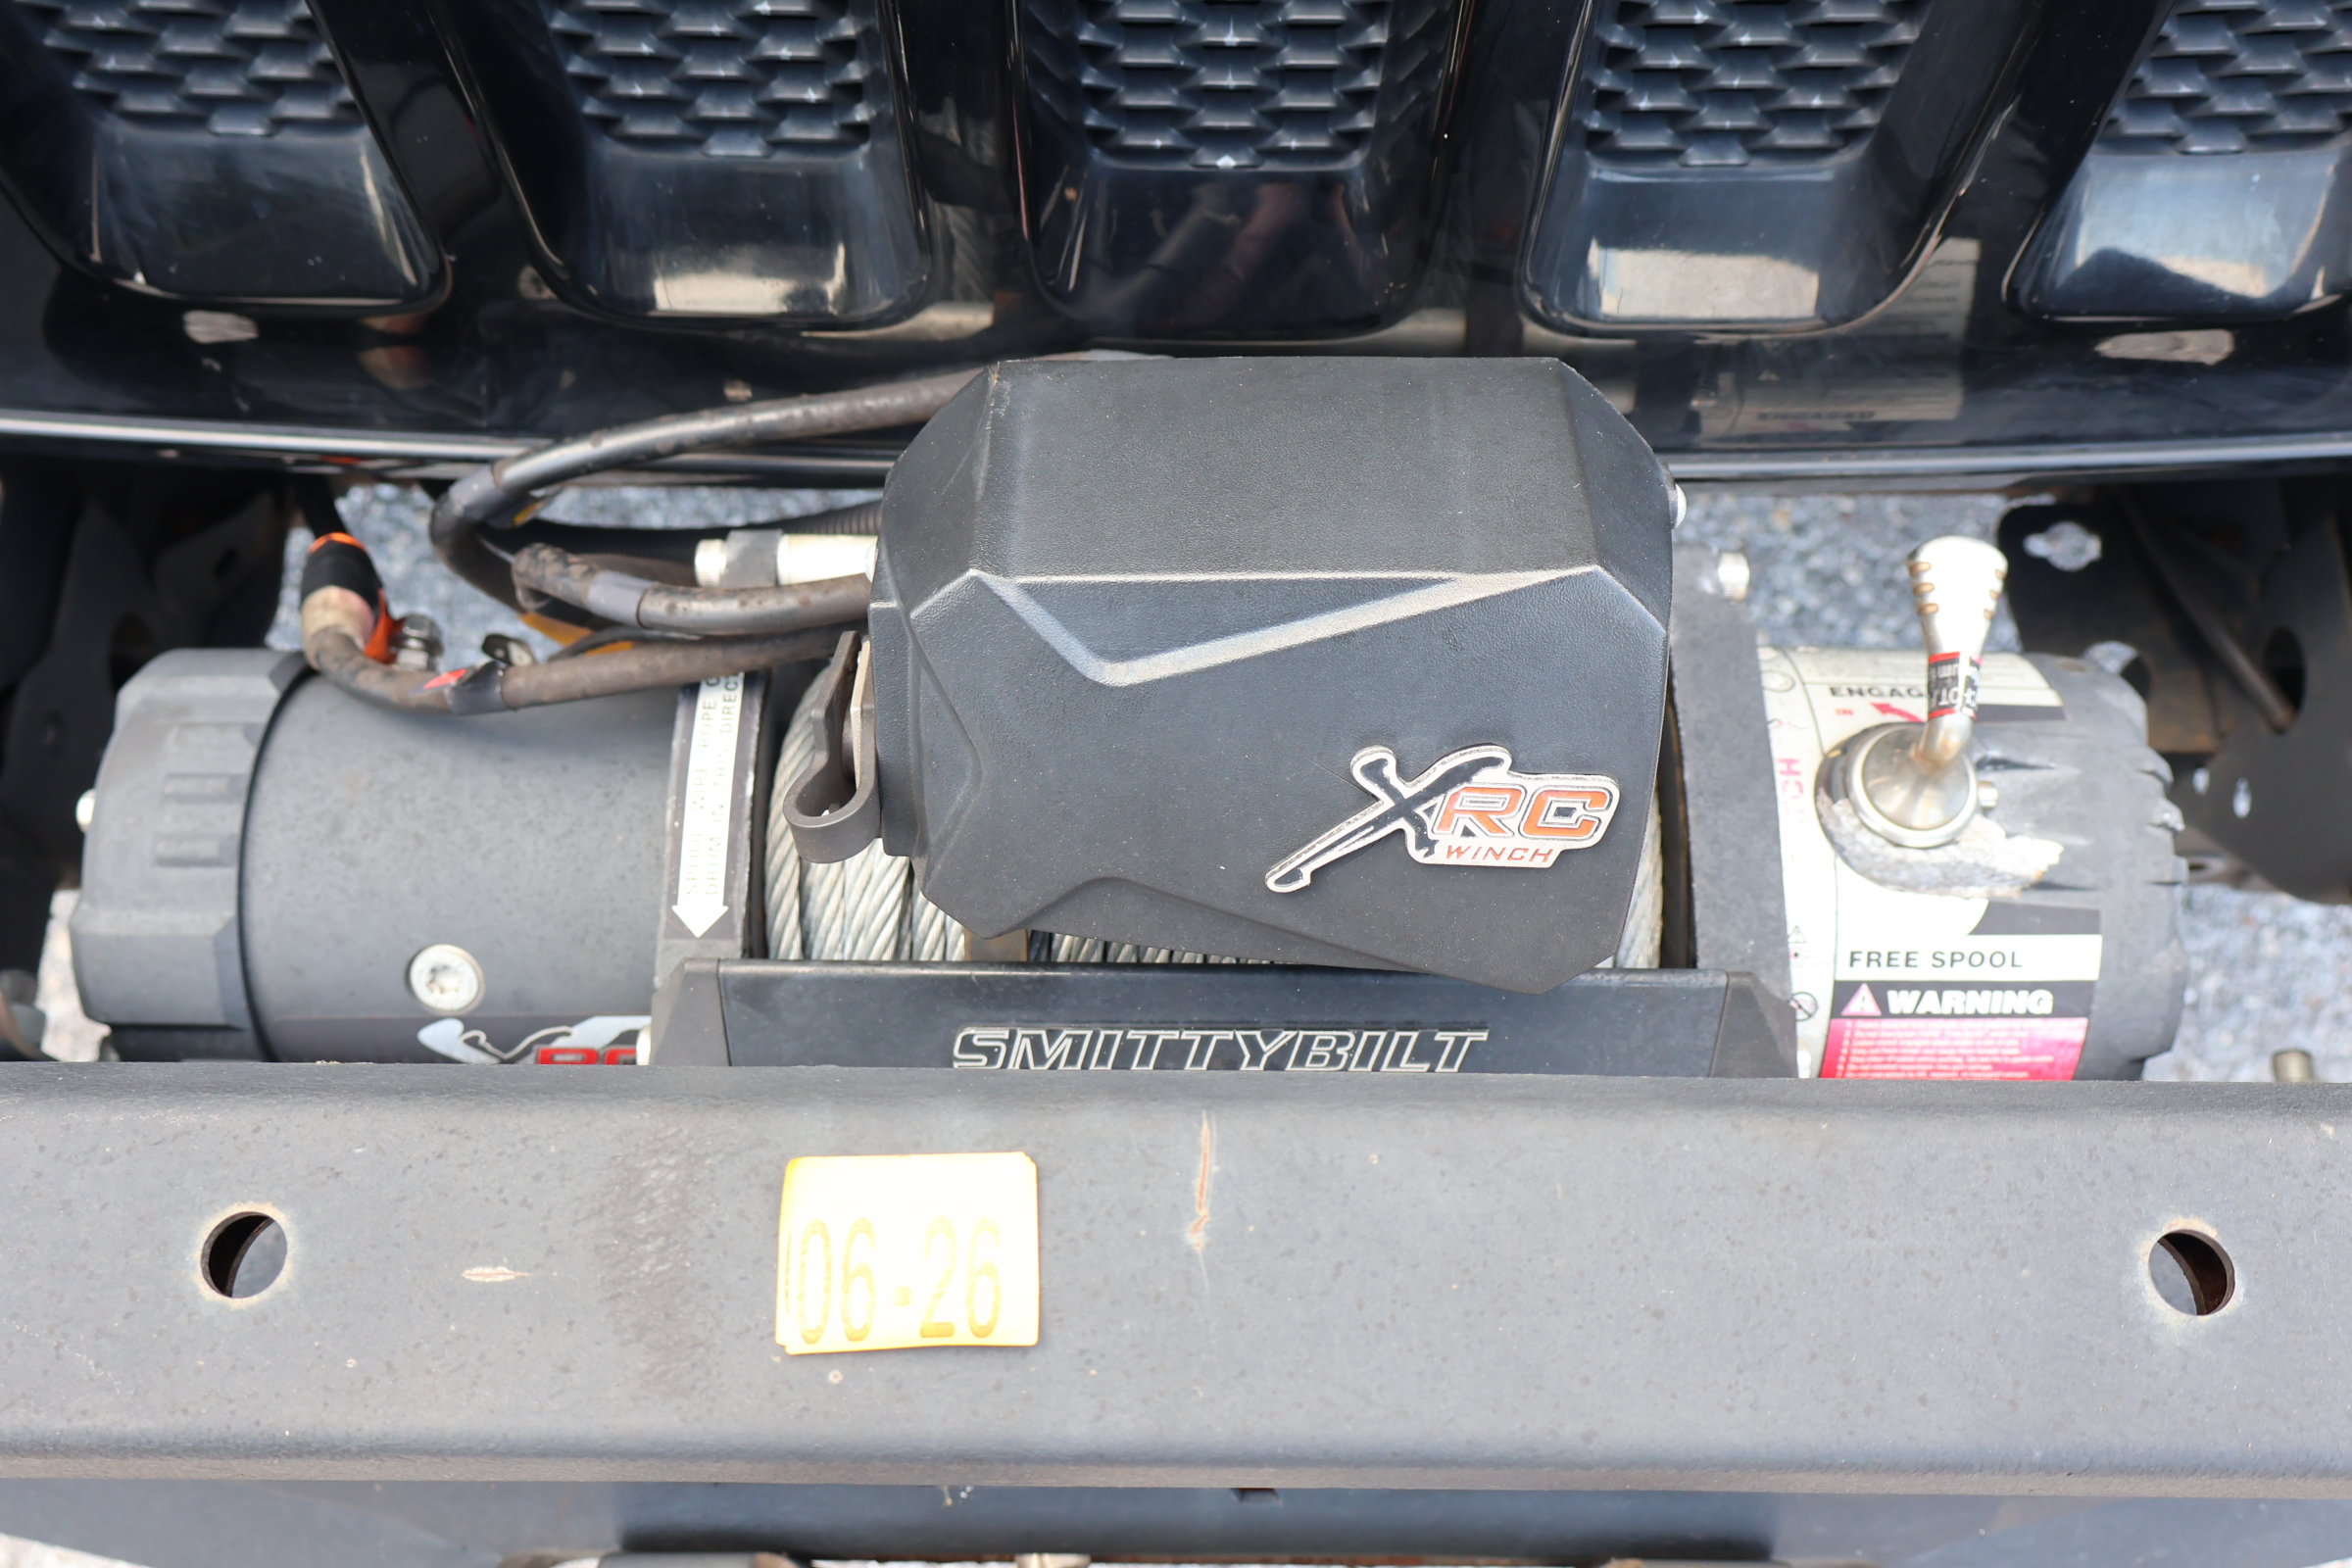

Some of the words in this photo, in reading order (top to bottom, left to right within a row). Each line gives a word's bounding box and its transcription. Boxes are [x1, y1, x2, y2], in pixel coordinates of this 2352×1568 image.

[719, 675, 739, 734] DIREC
[1829, 687, 1926, 698] ENGAG
[698, 700, 717, 748] ROPE
[1446, 845, 1553, 863] WINCH
[1849, 951, 1919, 968] FREE
[1931, 951, 2023, 968] SPOOL
[1886, 989, 2054, 1015] WARNING
[953, 1026, 1489, 1073] SMITTYBILT
